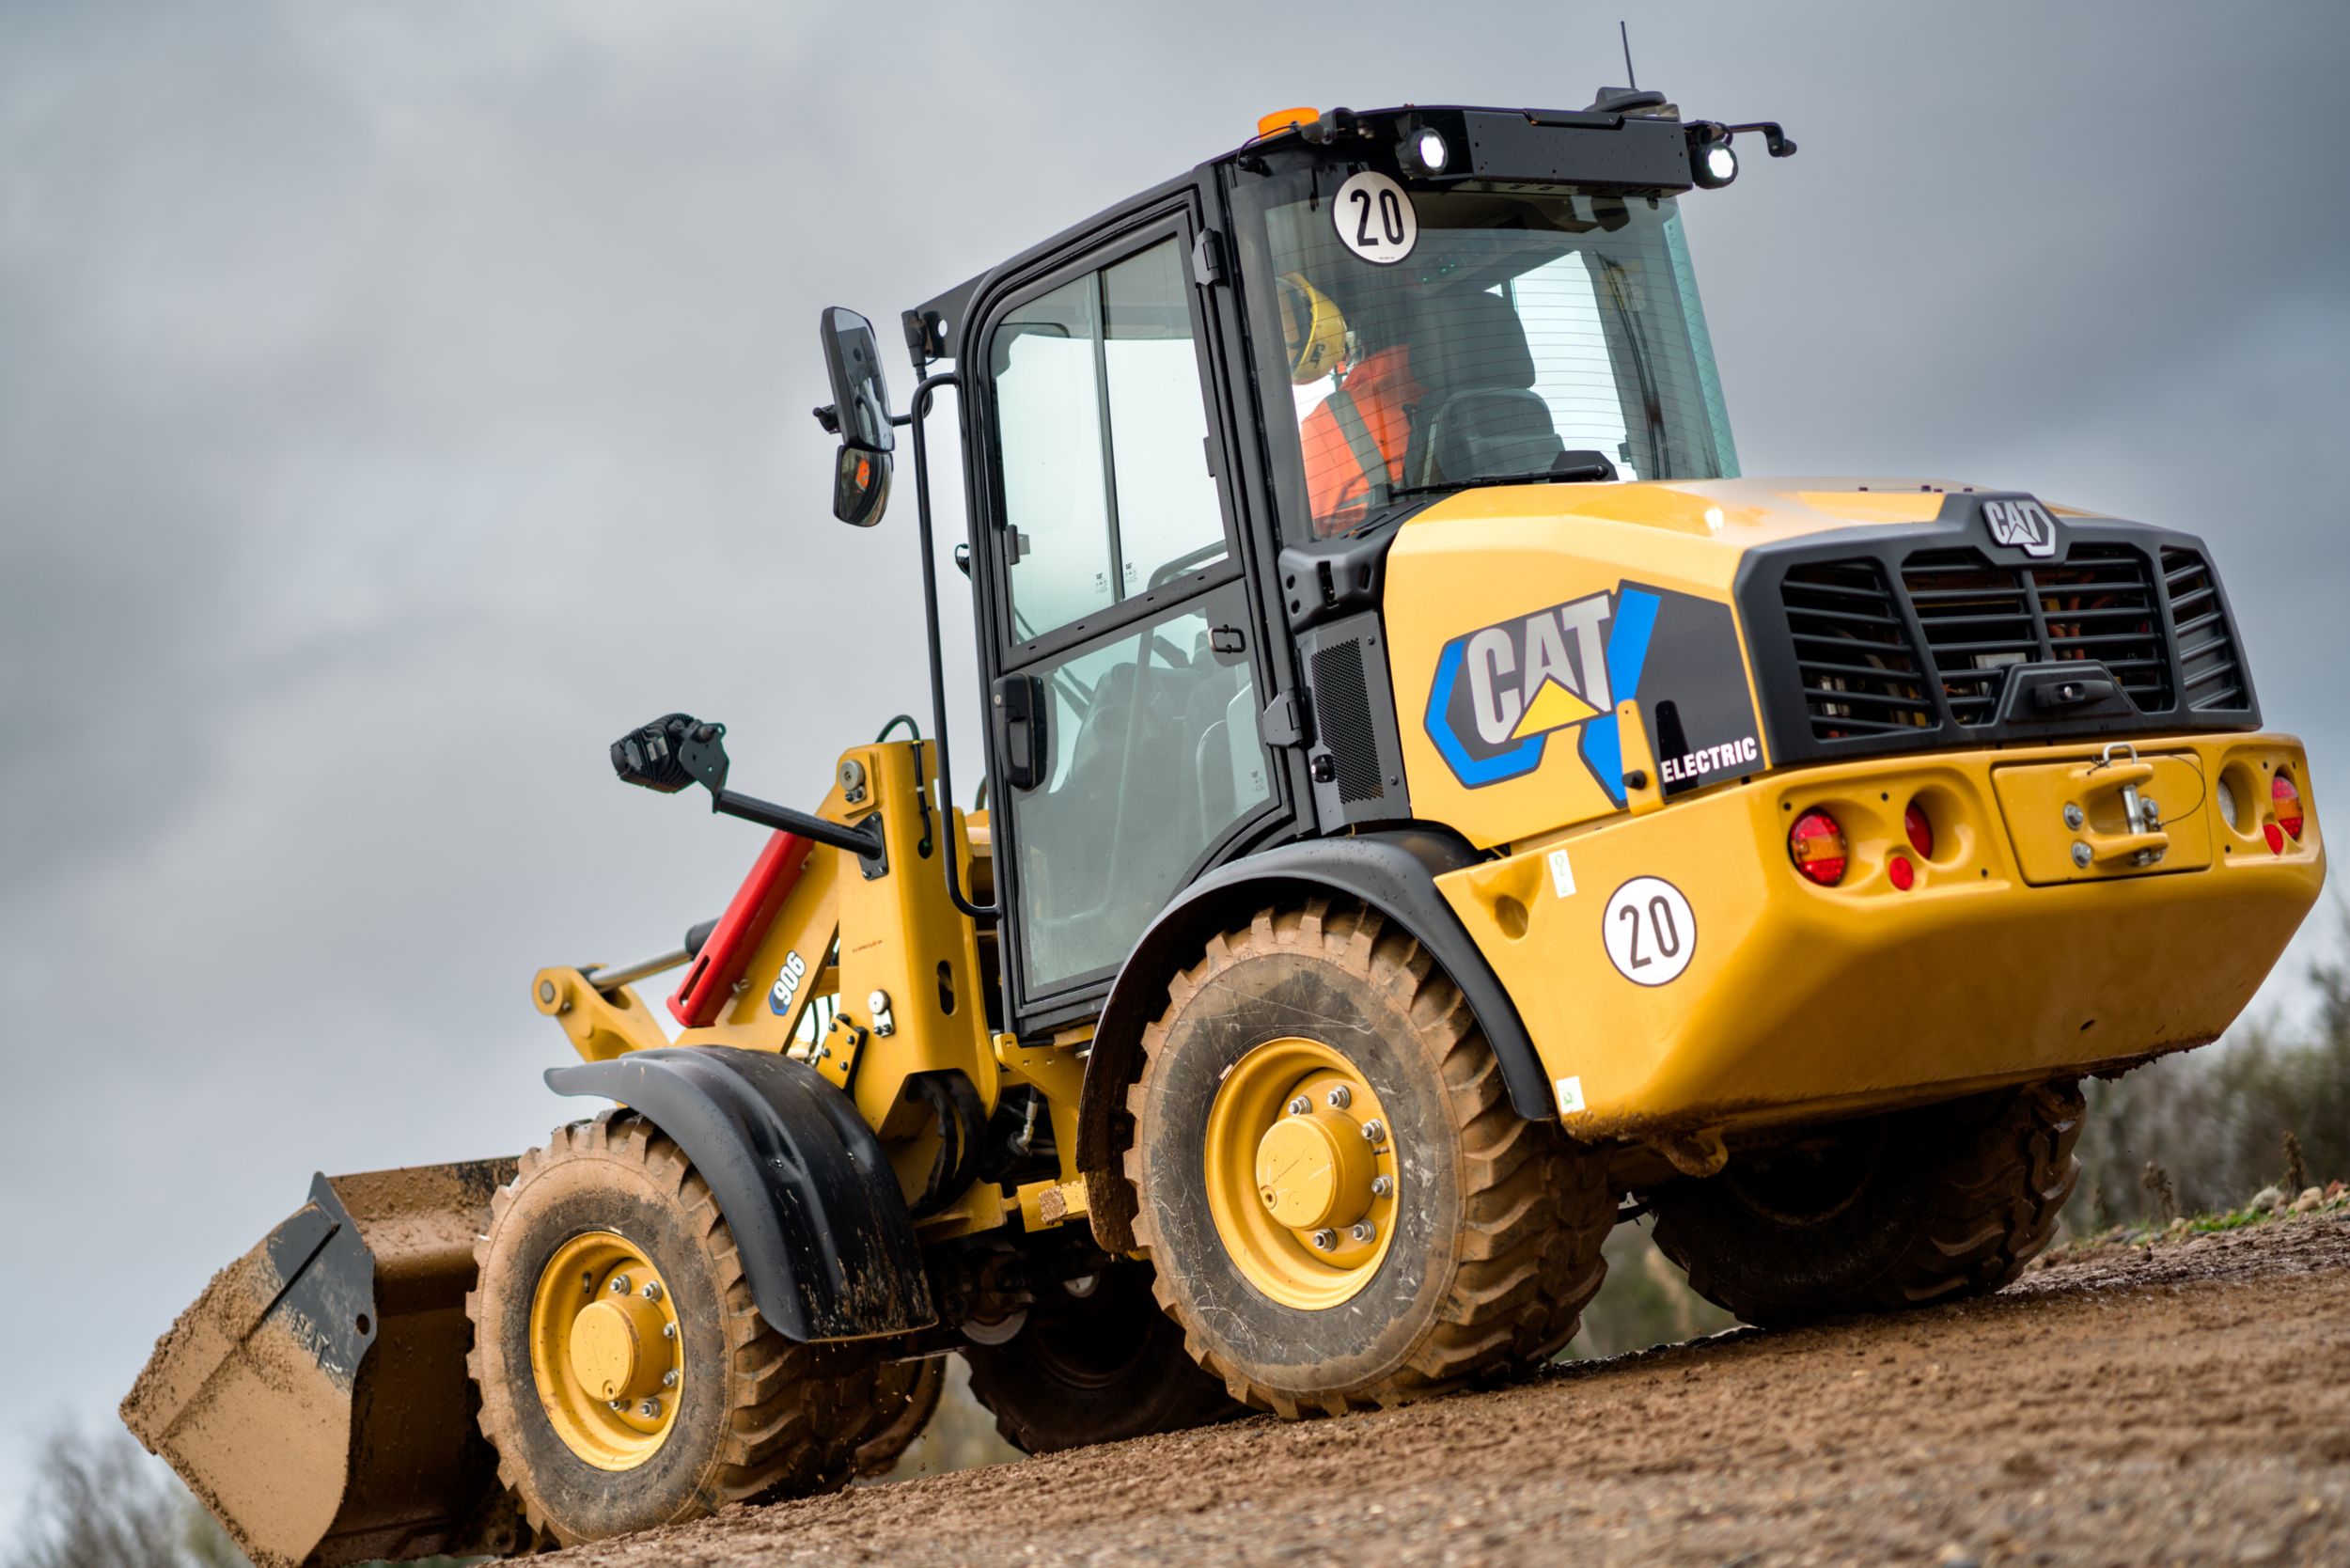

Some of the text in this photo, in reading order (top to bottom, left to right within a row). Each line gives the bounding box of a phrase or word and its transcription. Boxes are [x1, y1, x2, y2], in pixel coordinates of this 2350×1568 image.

[1350, 188, 1405, 246] 20
[1984, 501, 2042, 544] CAT
[1466, 594, 1611, 744] CAT
[1661, 737, 1757, 782] ELECTRIC
[1619, 895, 1680, 970] 20
[774, 951, 806, 1005] 906
